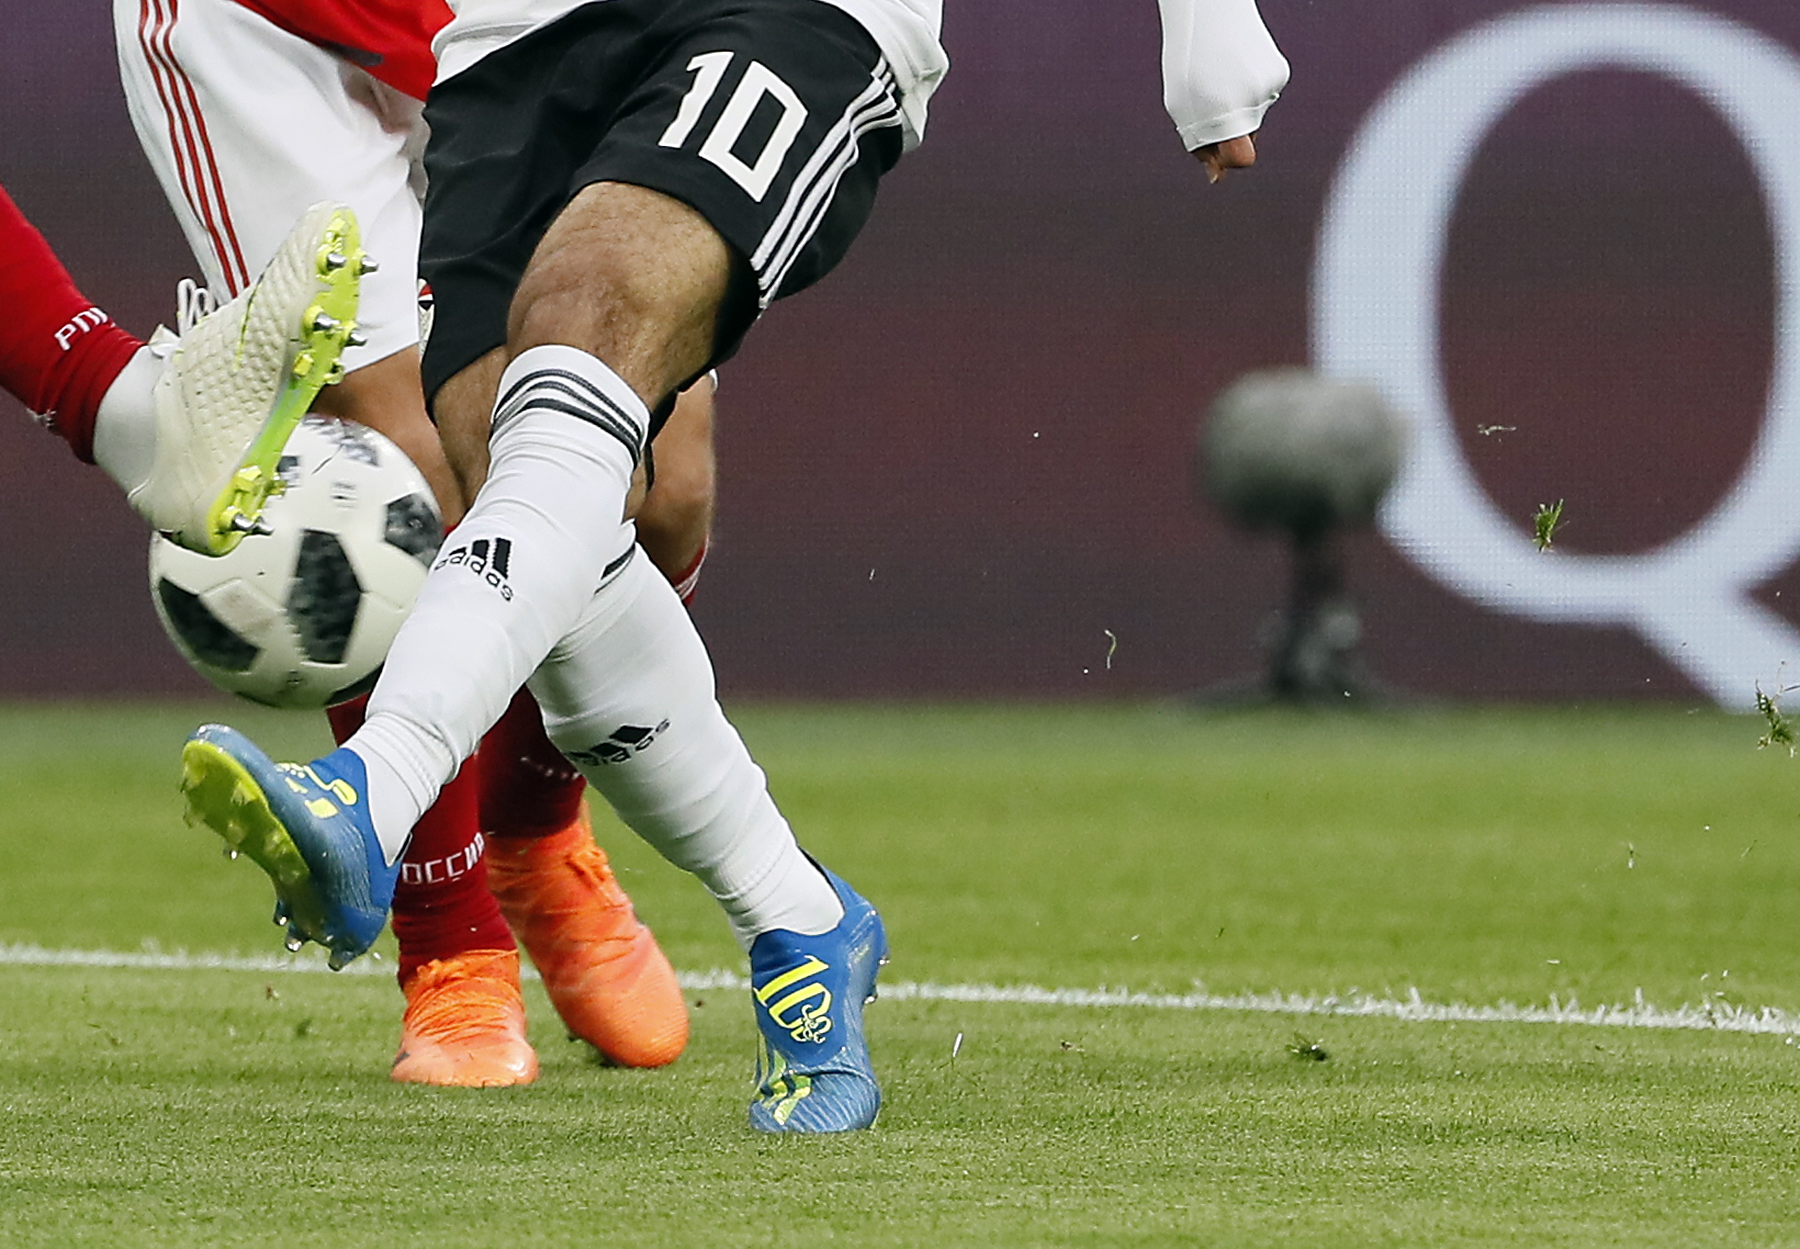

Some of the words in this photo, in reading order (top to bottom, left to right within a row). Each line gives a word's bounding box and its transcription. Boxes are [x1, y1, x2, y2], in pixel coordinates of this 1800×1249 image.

[657, 51, 809, 202] 10
[434, 556, 514, 603] adidas
[752, 954, 833, 1035] 10
